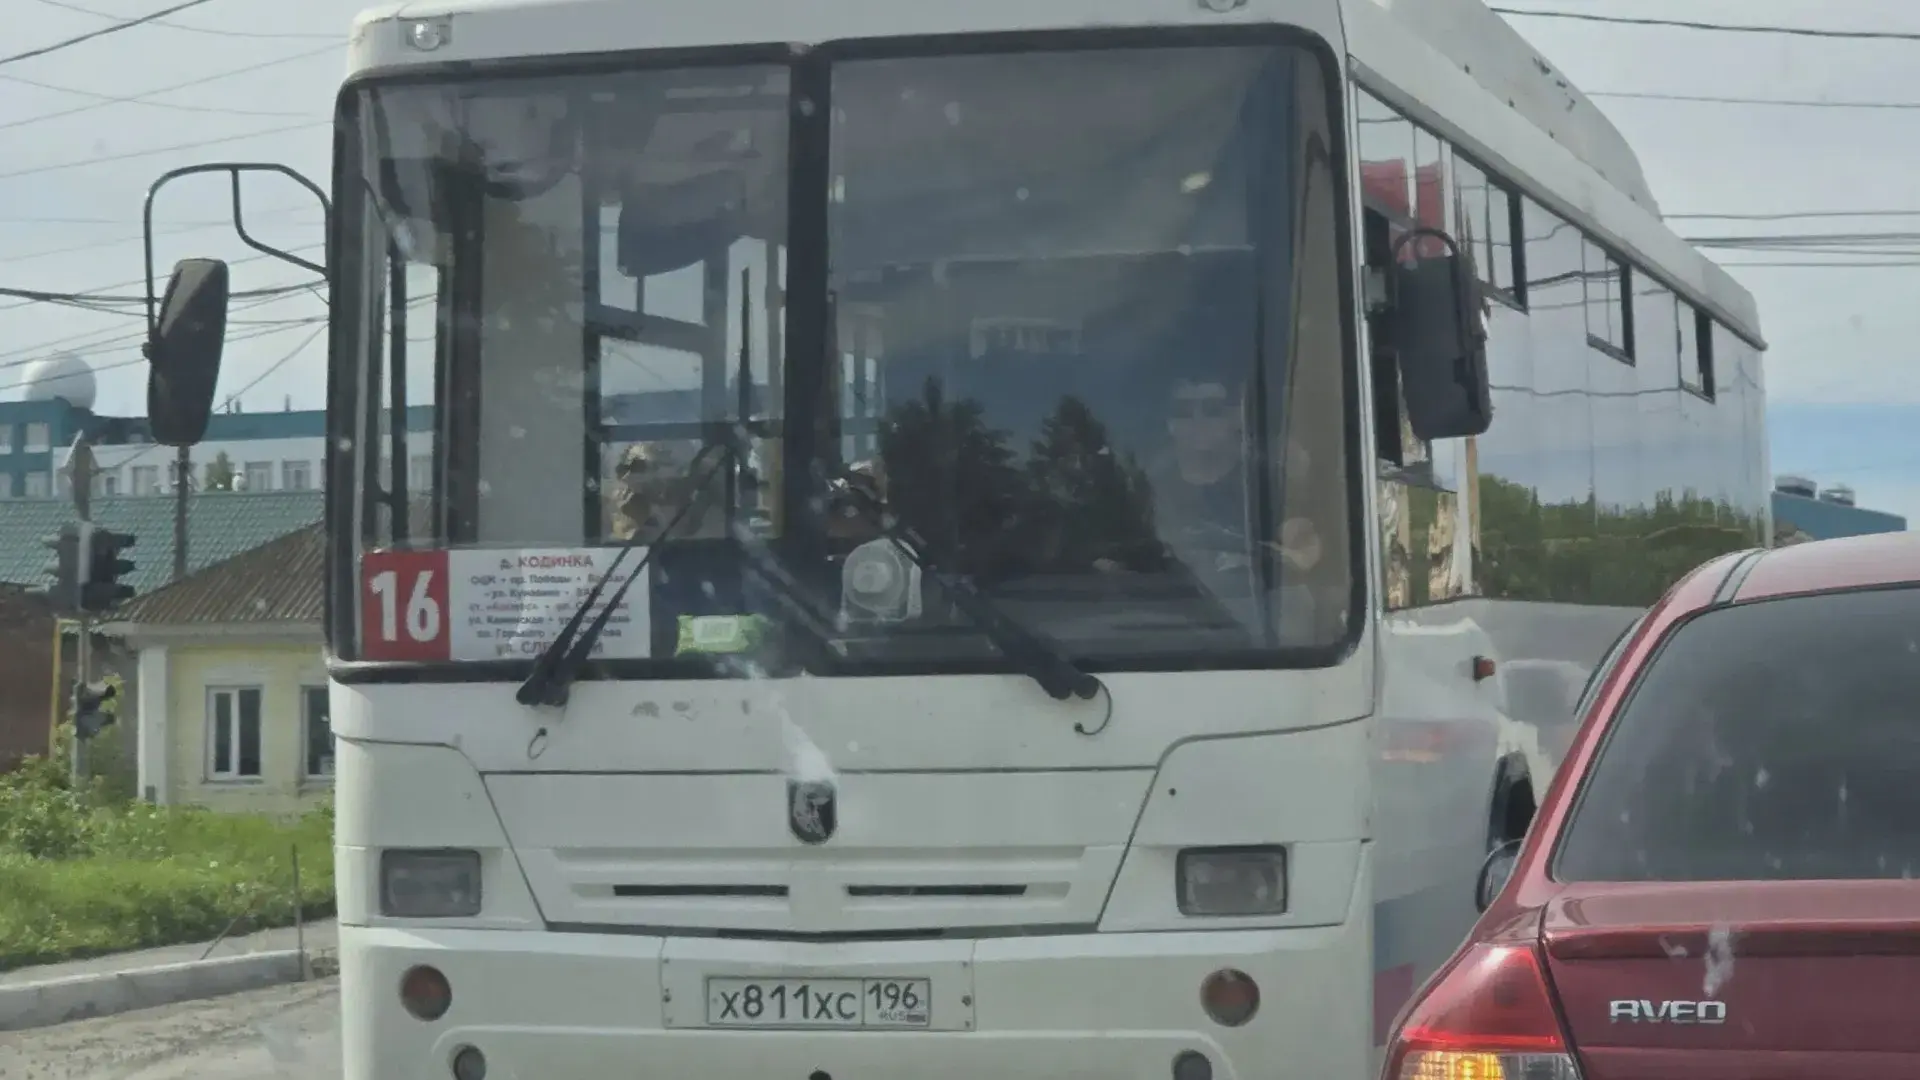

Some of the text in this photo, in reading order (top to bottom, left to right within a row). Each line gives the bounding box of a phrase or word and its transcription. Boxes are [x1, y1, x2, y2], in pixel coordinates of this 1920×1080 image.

[518, 555, 594, 568] КОДИНКА
[370, 570, 440, 642] 16
[868, 982, 919, 1010] 196
[1610, 1000, 1726, 1024] AVEO
